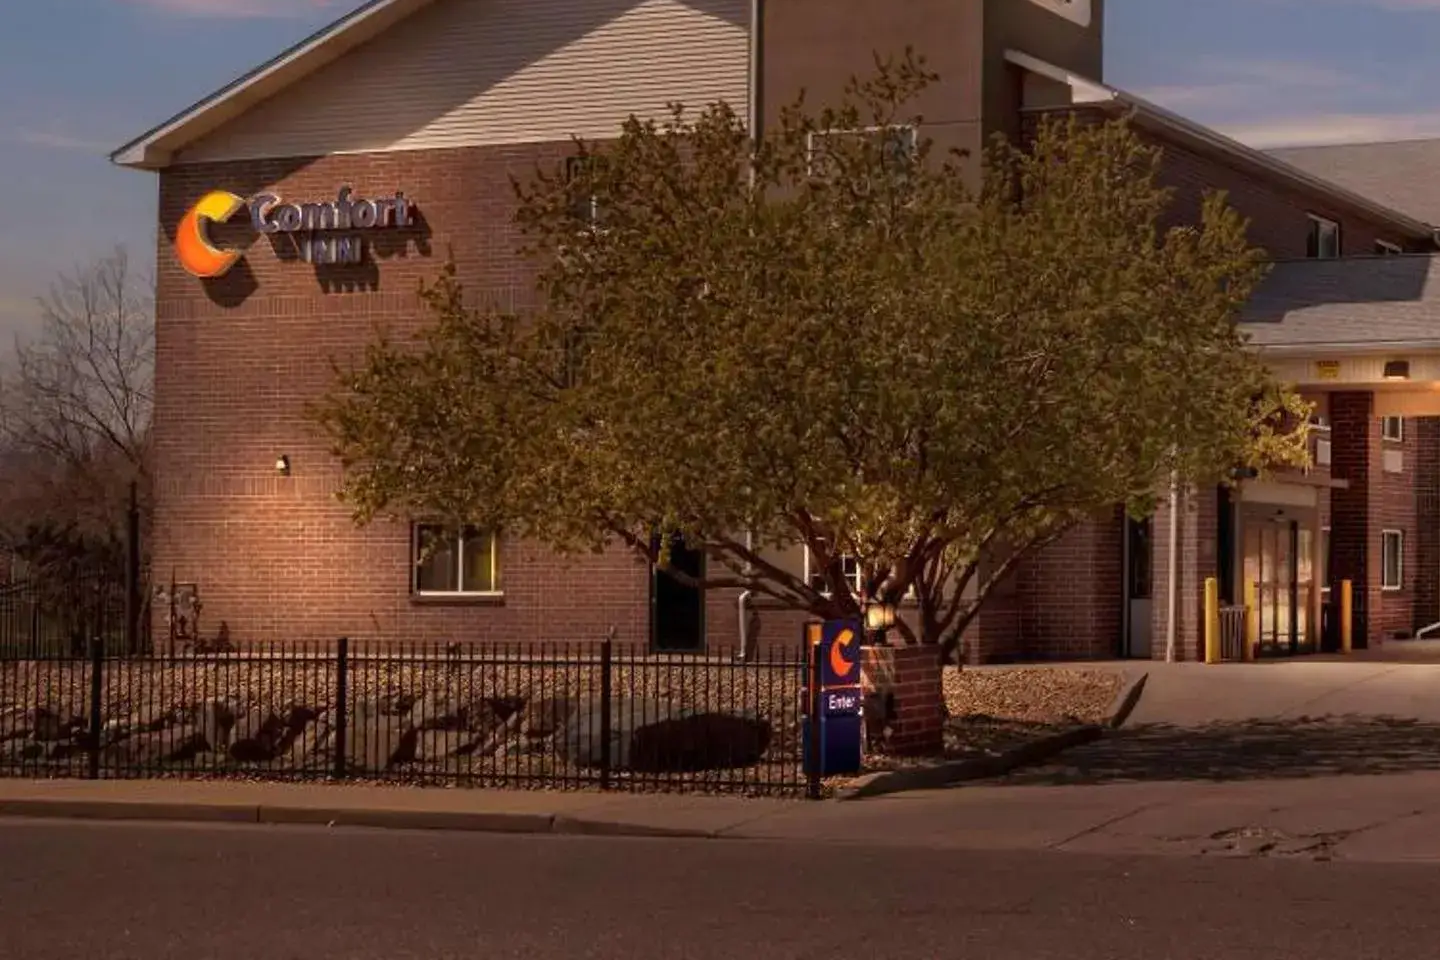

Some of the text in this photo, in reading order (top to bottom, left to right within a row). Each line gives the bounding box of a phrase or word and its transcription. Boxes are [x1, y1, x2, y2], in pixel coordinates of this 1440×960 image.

[251, 185, 413, 232] Comfort
[303, 238, 362, 263] INN
[828, 694, 855, 709] Enter
